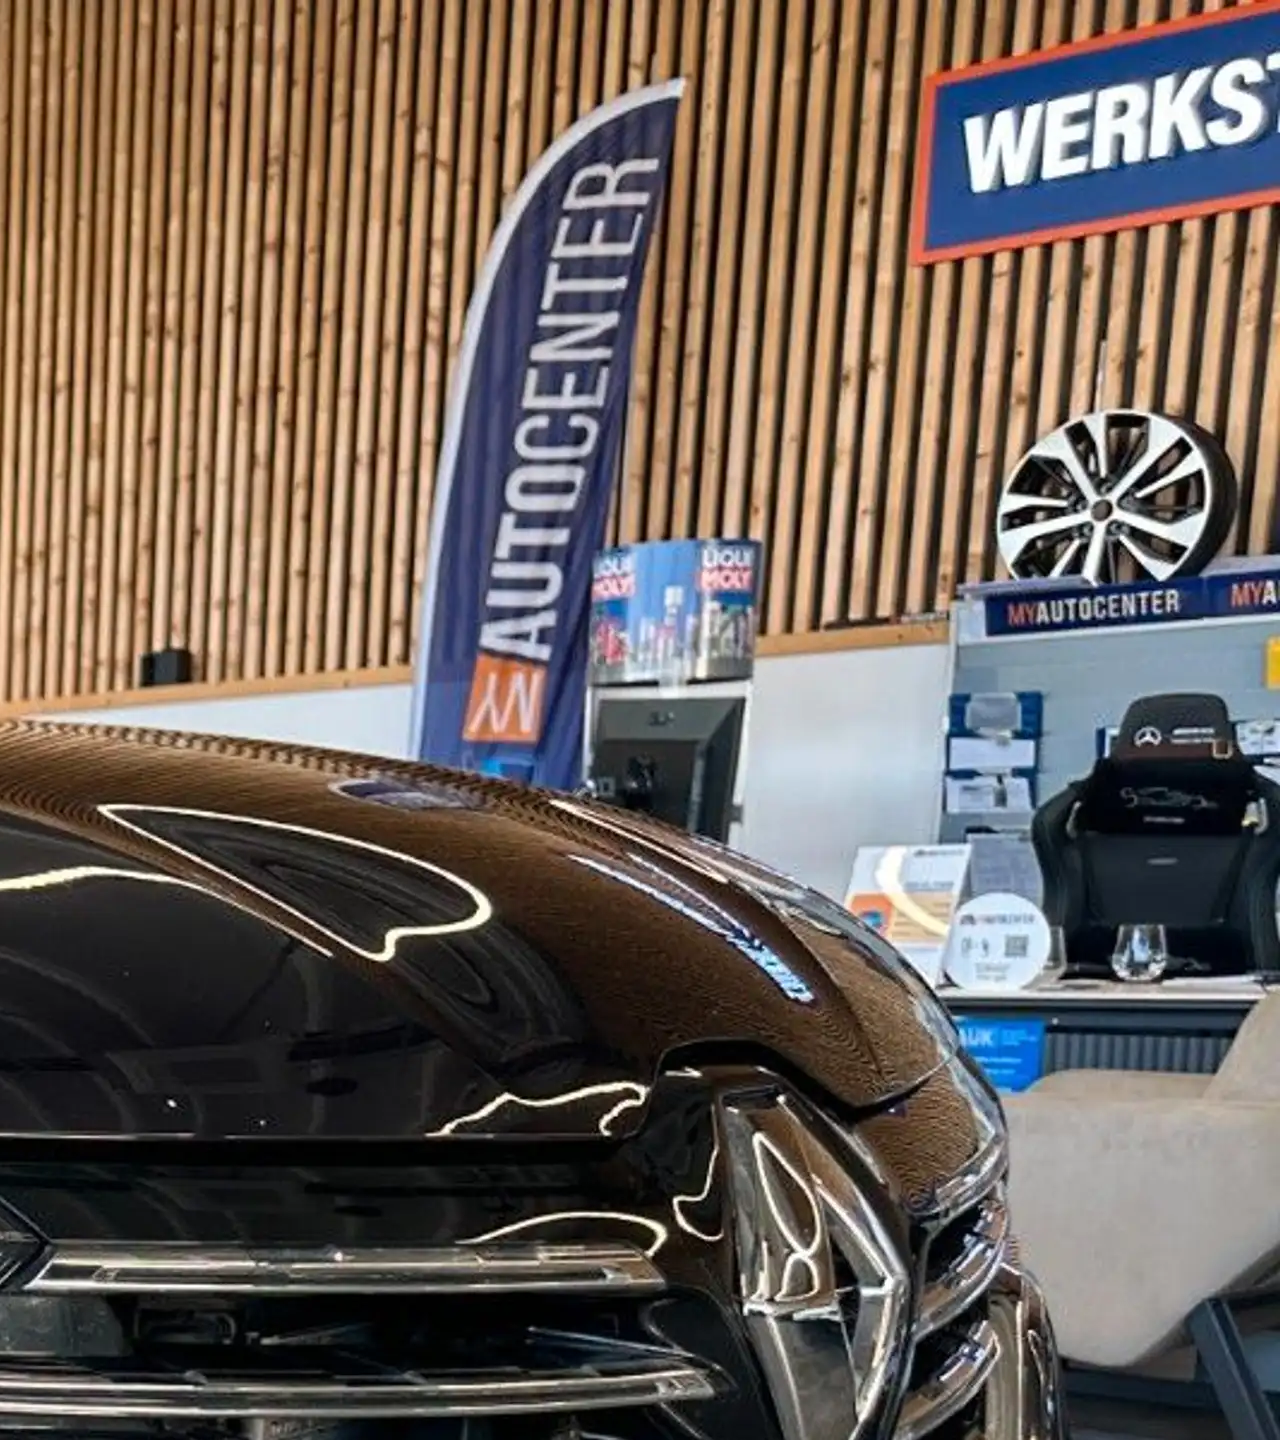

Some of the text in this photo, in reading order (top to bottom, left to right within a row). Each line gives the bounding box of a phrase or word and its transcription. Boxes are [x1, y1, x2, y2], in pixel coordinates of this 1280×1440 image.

[963, 52, 1280, 193] WERKS
[1007, 589, 1180, 627] MYAUTOCENTER
[1231, 579, 1280, 608] MYA
